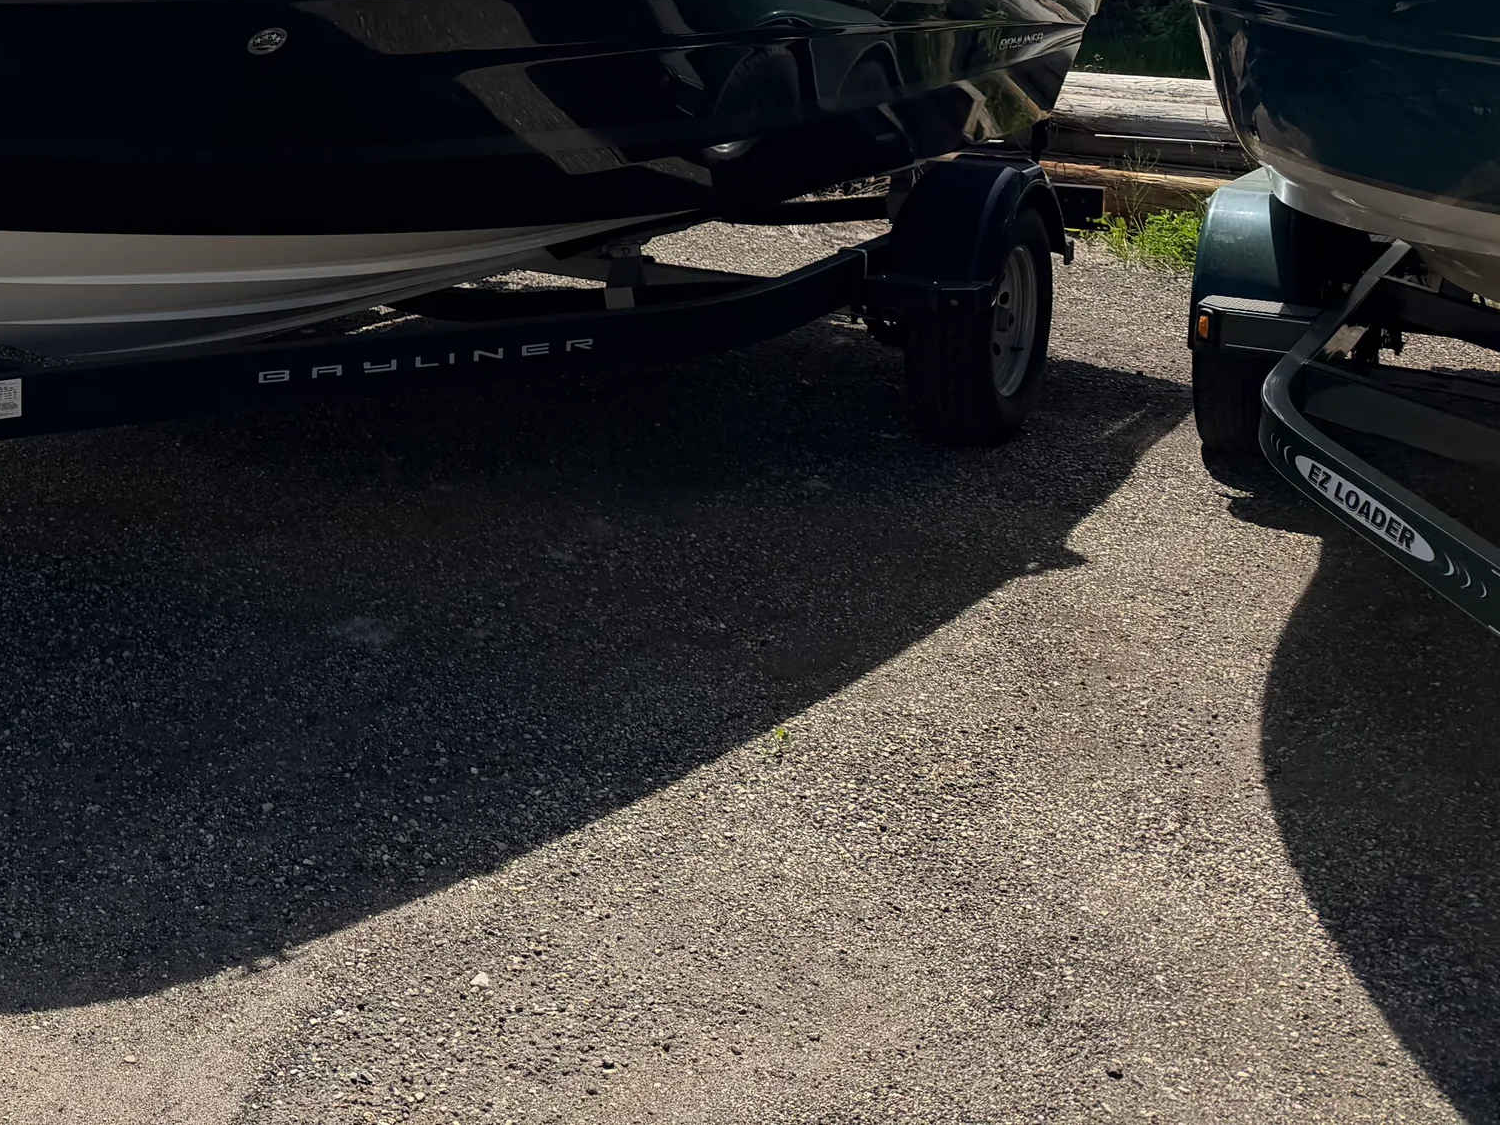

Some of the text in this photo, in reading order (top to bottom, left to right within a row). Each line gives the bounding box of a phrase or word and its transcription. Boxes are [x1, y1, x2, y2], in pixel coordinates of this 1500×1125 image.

[258, 338, 593, 384] BAYLINER
[1308, 463, 1416, 553] EZ LOADER
